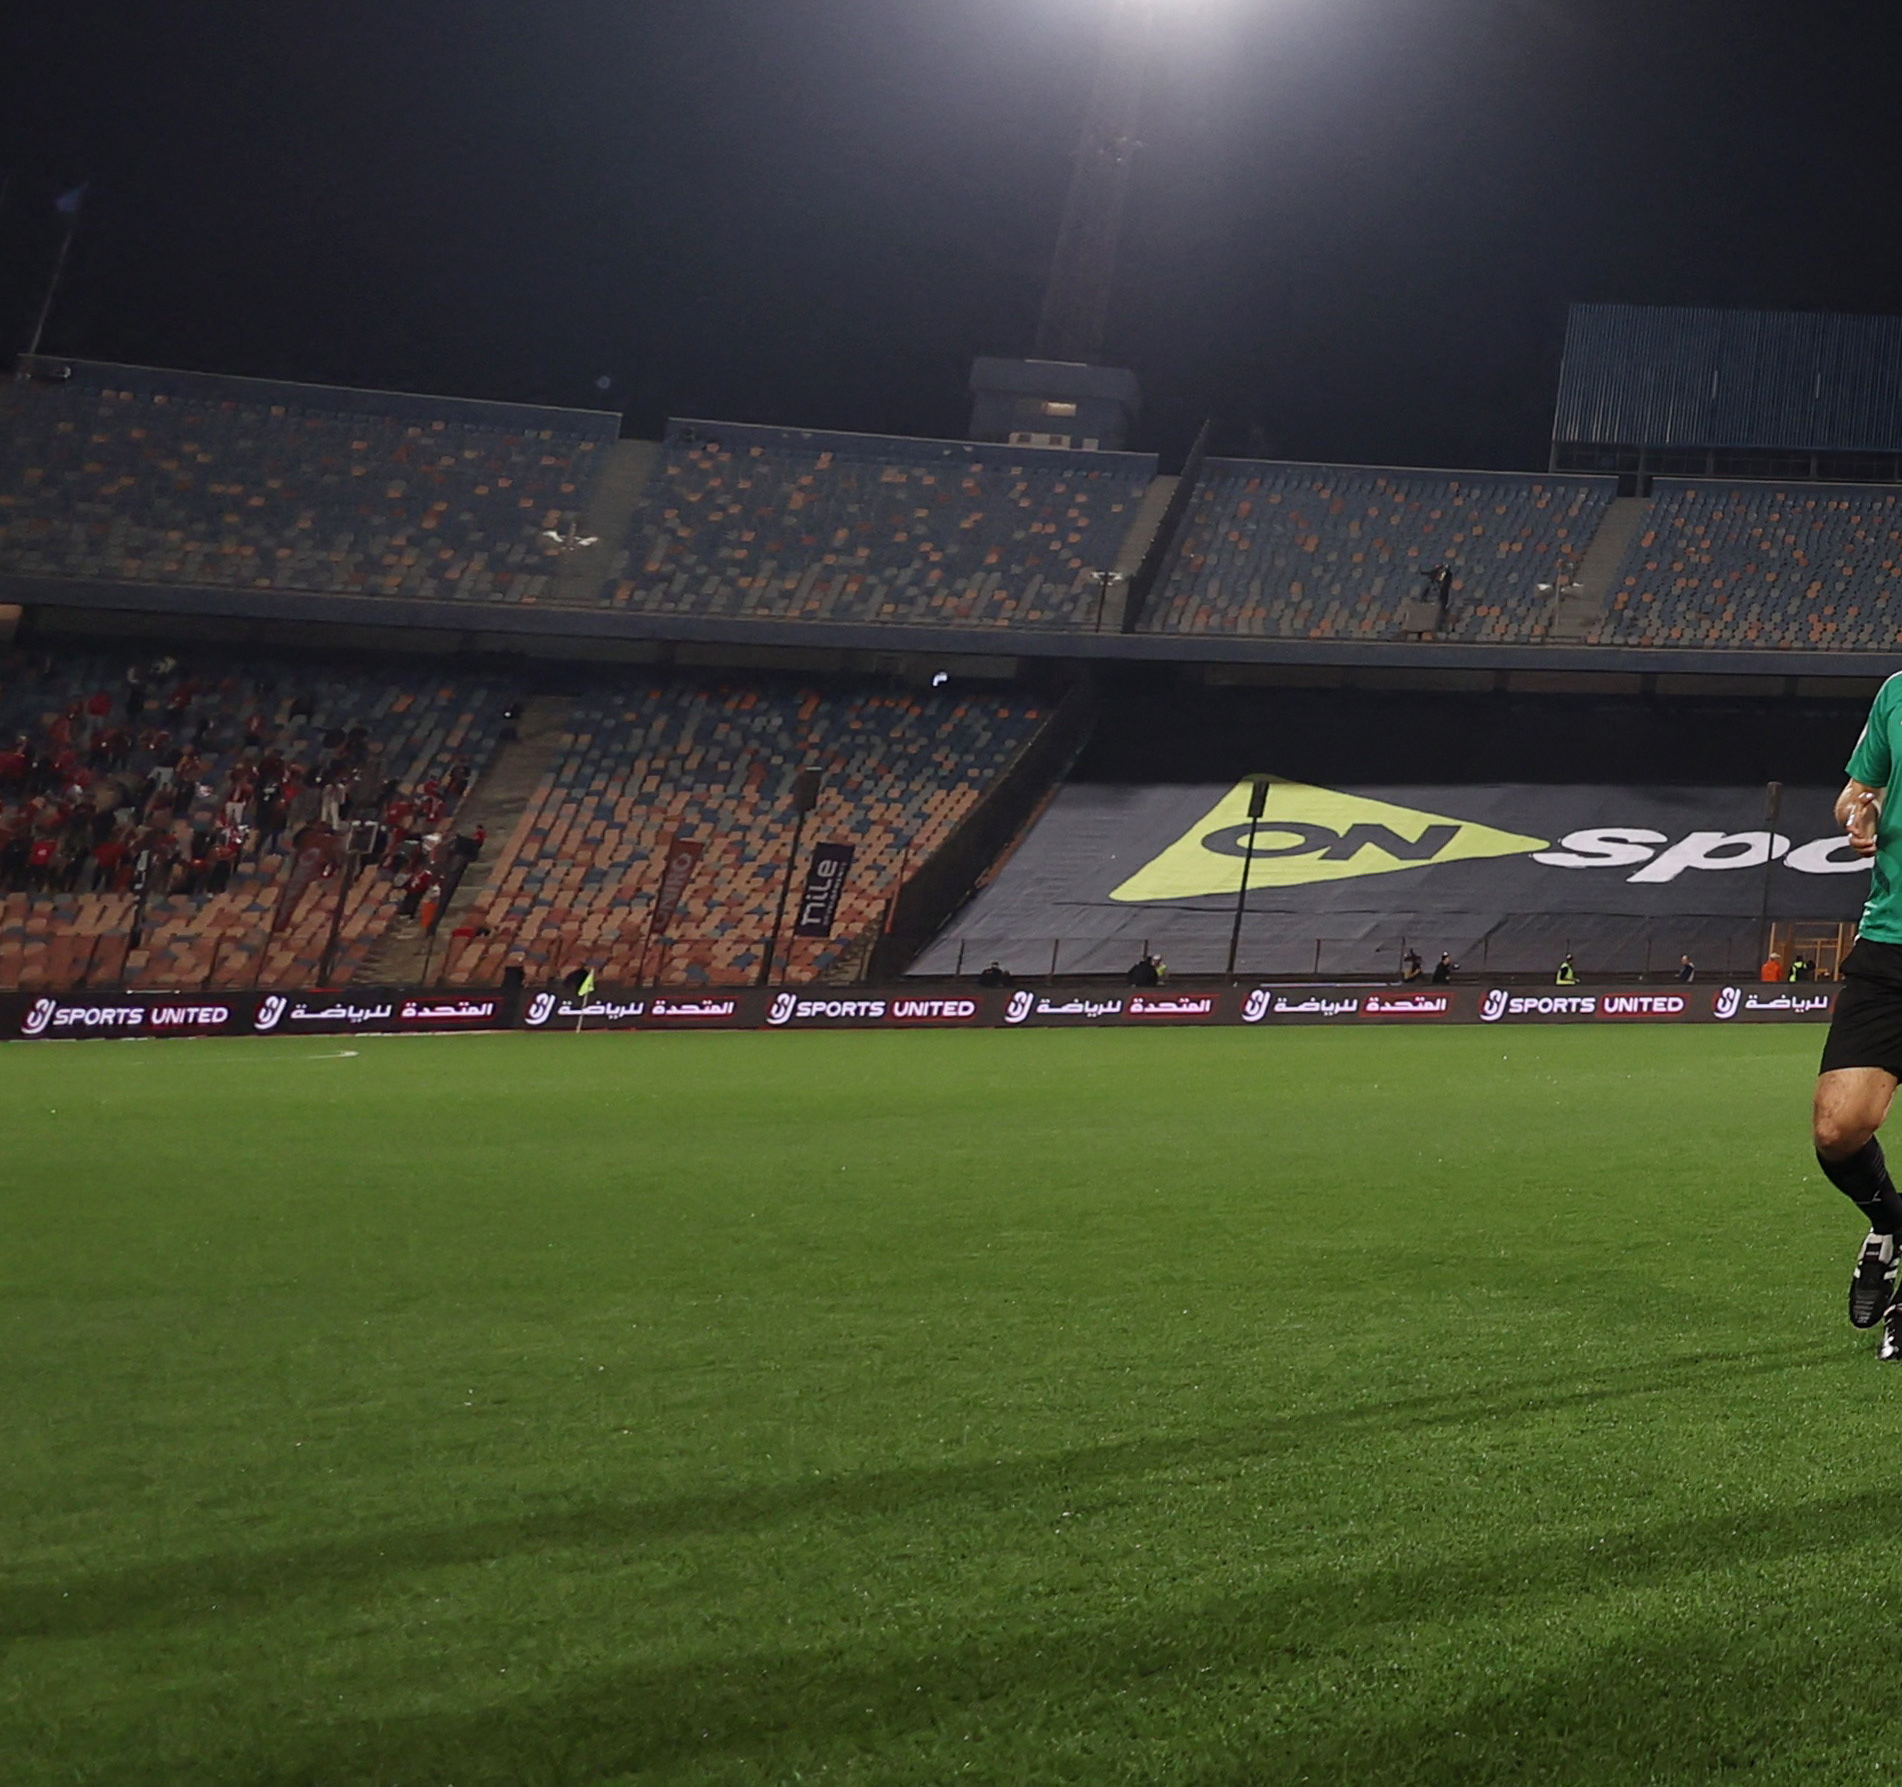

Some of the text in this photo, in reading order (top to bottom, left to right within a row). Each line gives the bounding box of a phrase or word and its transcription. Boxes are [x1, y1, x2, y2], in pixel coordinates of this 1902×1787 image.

[1201, 821, 1463, 860] ON
[291, 1001, 493, 1023] المتحدة للرياضة
[652, 1000, 735, 1014] المتحدة
[796, 1001, 975, 1017] SPORTS UNITED
[1036, 998, 1211, 1017] المتحدة للرياضة
[1273, 997, 1447, 1015] المتحدة للرياضة
[1508, 997, 1684, 1013] SPORTS UNITED
[1744, 995, 1828, 1012] للرياضة
[53, 1007, 228, 1025] SPORTS UNITED
